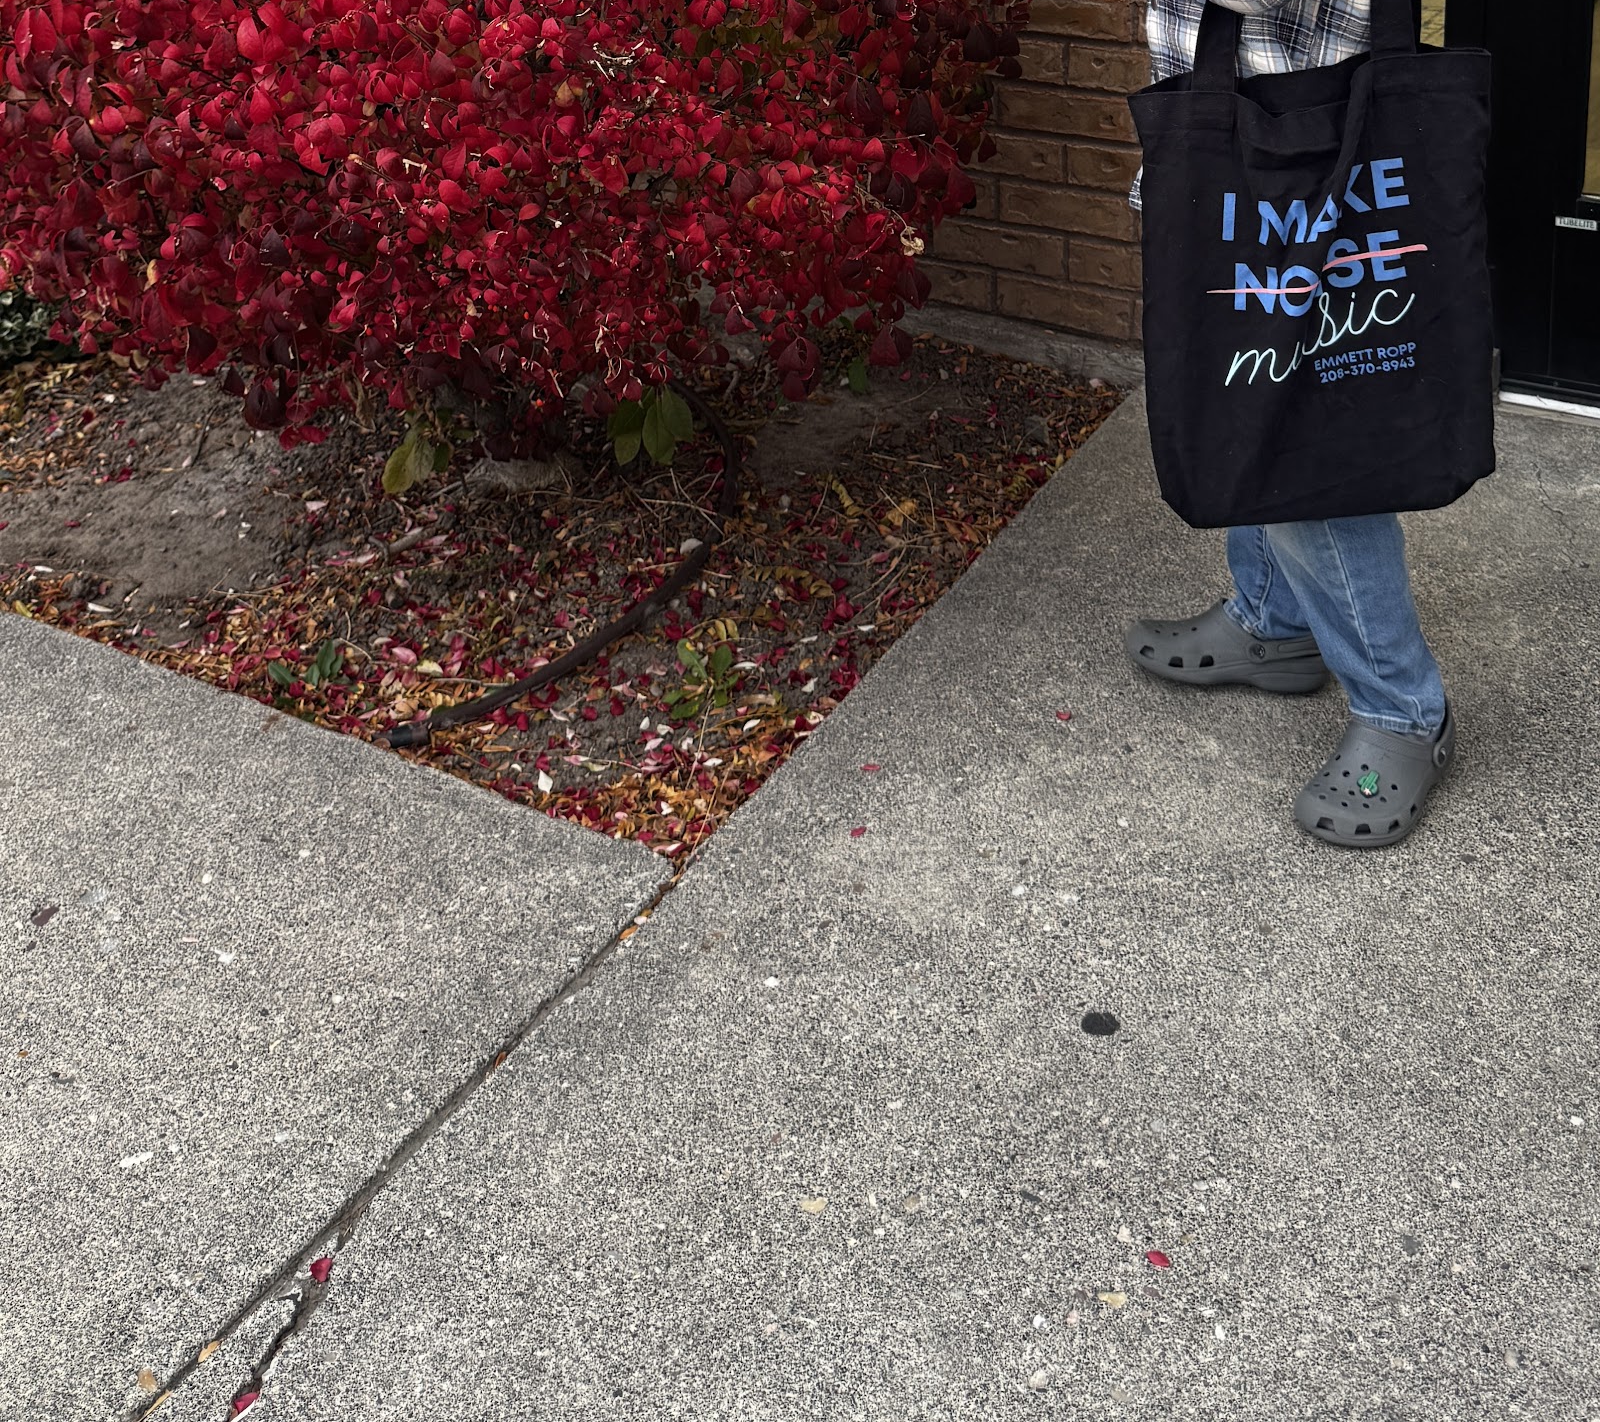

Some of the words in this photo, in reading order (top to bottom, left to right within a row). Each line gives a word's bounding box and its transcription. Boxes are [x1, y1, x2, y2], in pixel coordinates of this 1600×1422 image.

[1221, 192, 1237, 242] I
[1257, 157, 1411, 246] MAKE
[1224, 288, 1416, 387] music
[1314, 348, 1374, 371] EMMETT
[1376, 341, 1417, 360] ROPP
[1319, 356, 1416, 384] 208-370-8943
